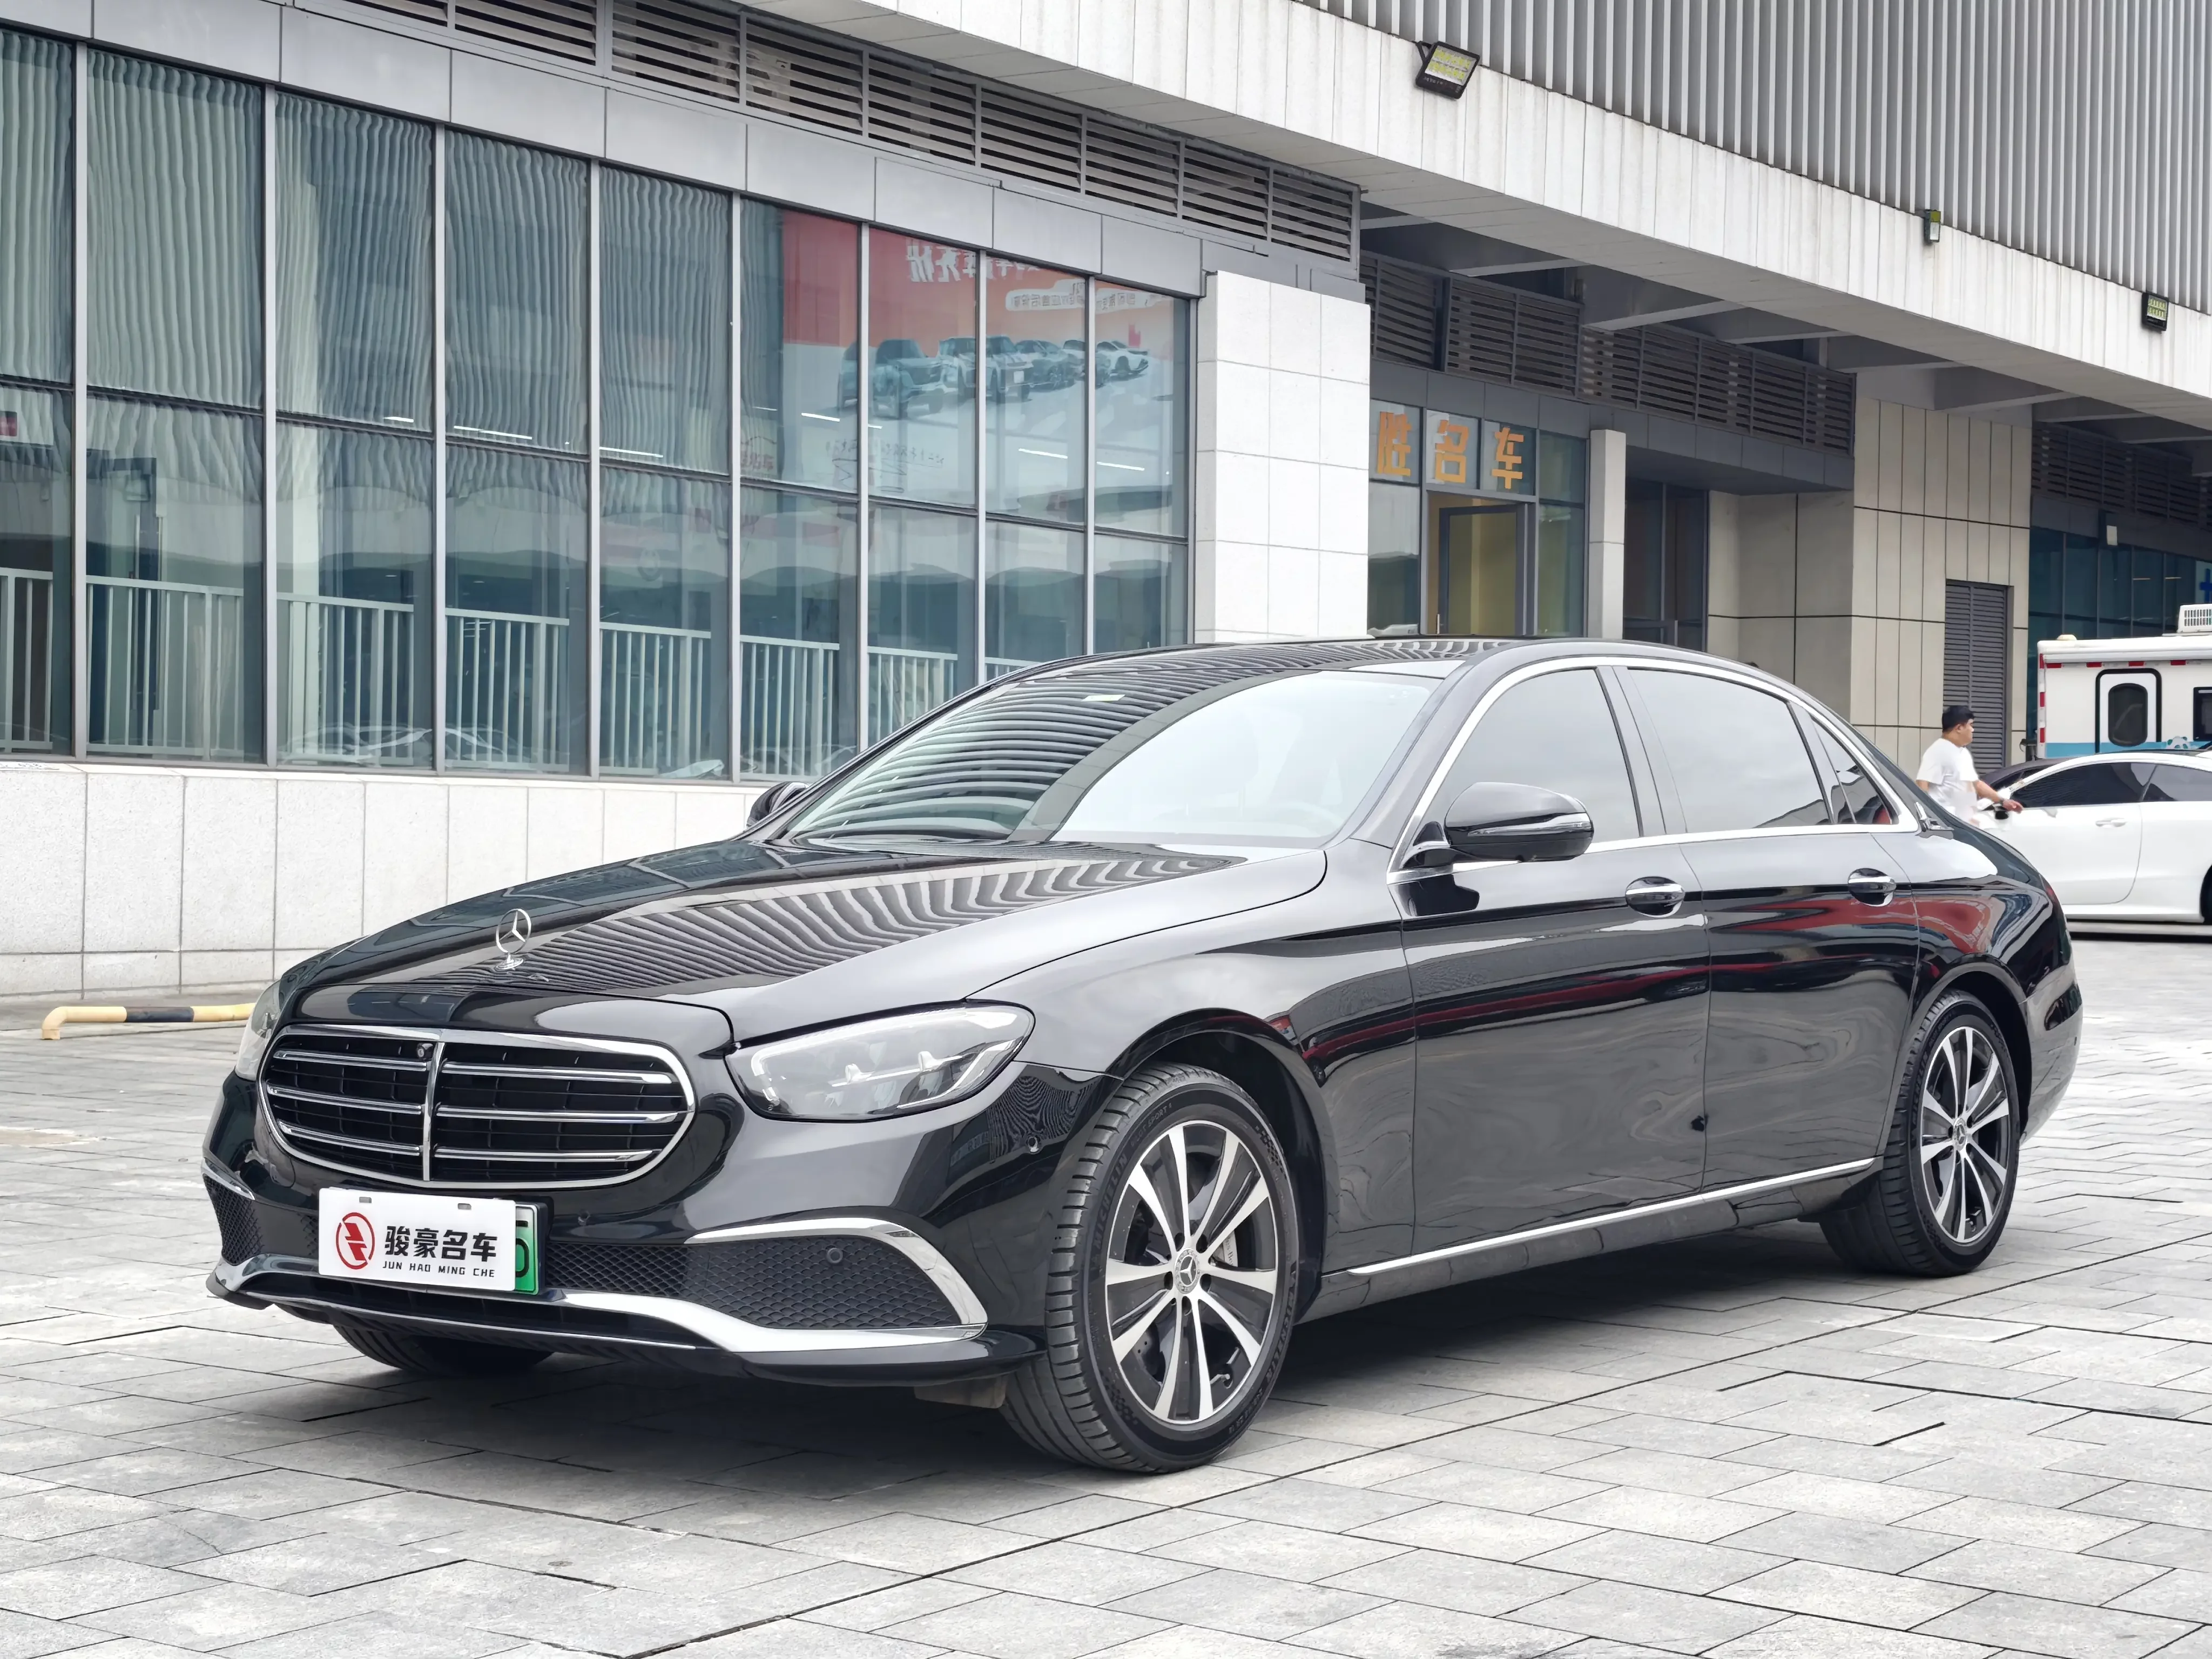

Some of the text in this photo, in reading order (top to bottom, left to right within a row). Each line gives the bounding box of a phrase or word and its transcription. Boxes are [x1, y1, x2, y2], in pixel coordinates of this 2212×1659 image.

[384, 1225, 497, 1262] 骏豪名车
[382, 1261, 495, 1278] JUN HAO MING CHE
